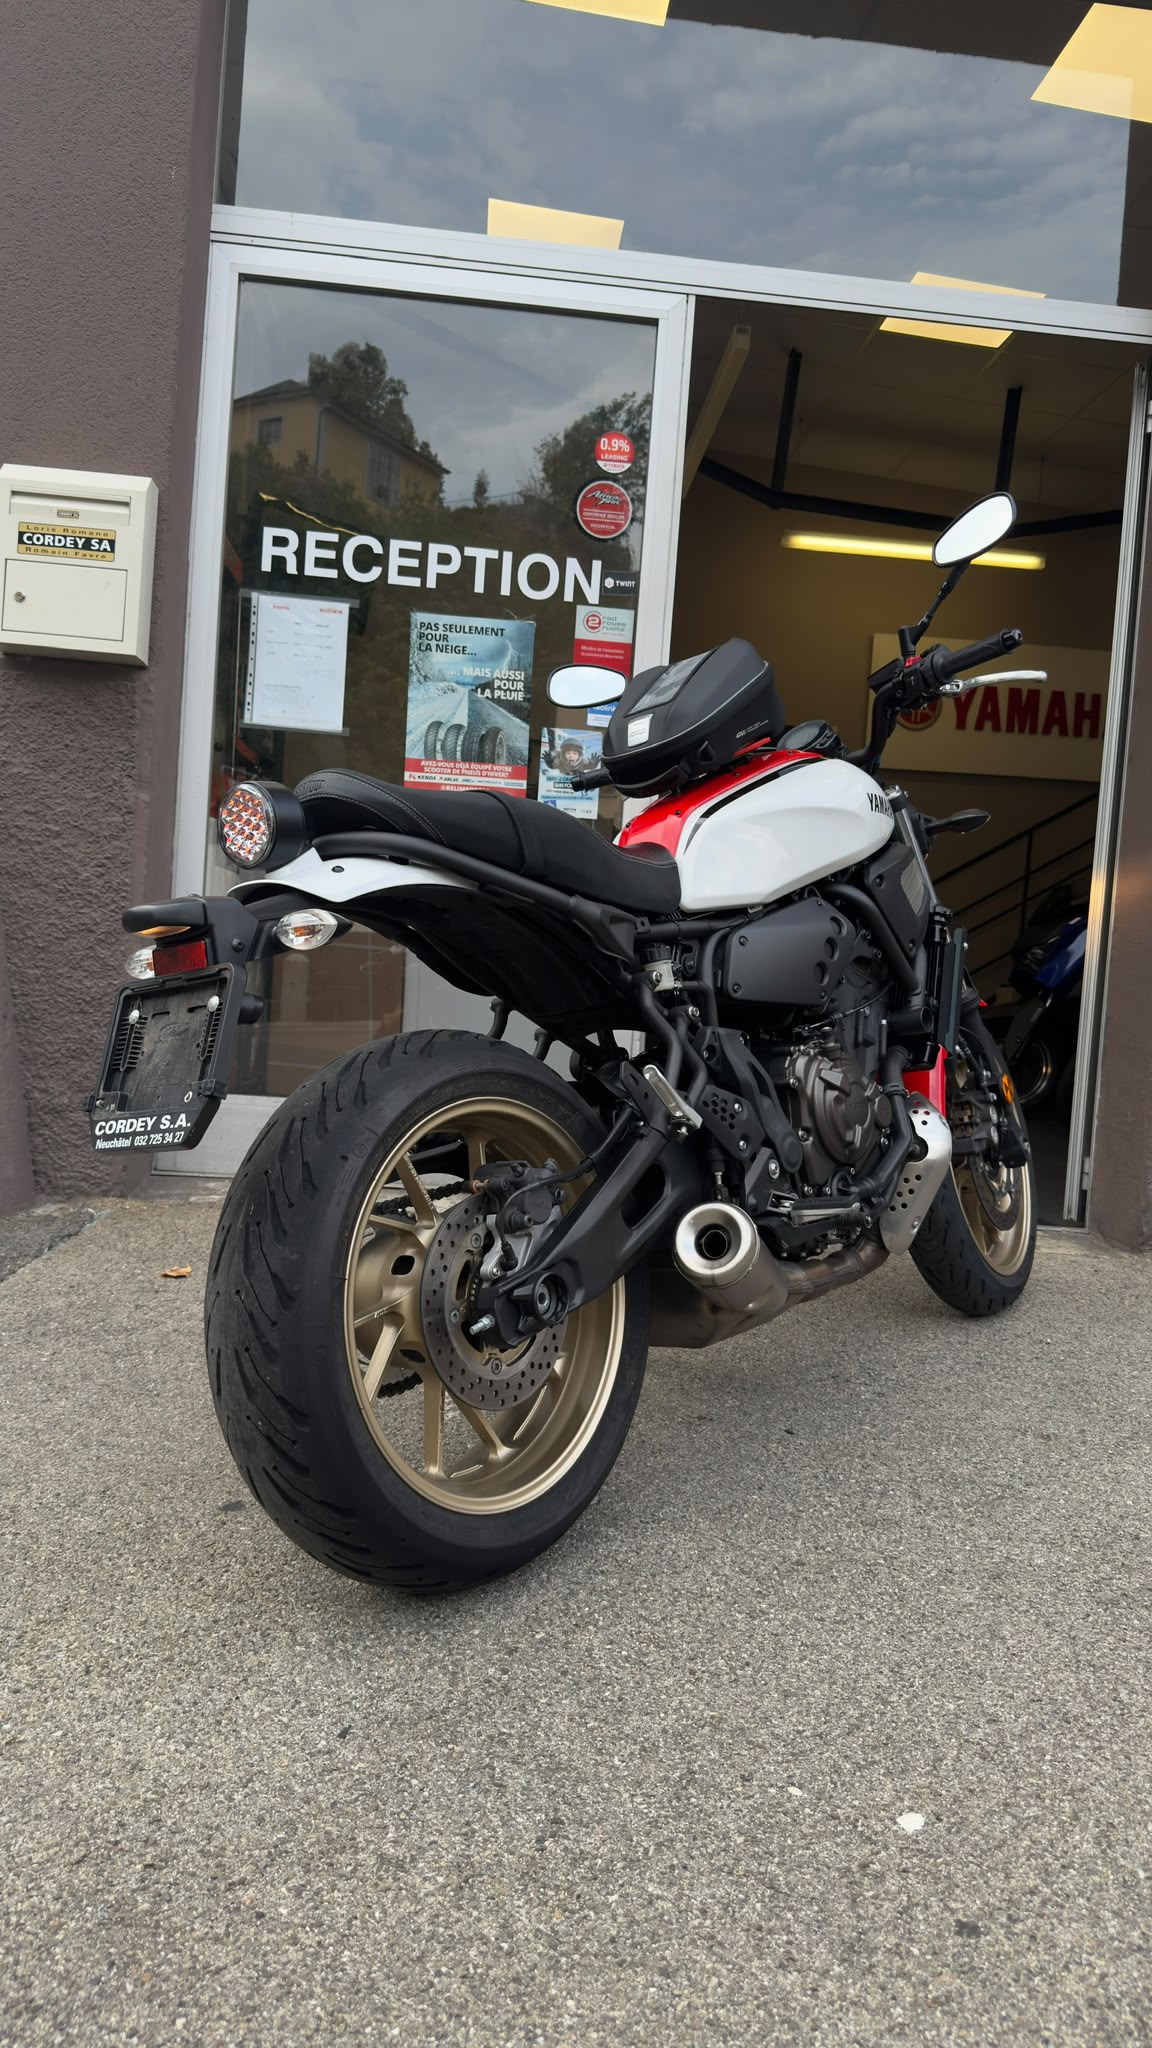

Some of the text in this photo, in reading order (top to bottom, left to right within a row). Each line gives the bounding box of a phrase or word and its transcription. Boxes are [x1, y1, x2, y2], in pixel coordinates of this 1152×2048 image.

[600, 438, 630, 452] 0.9%
[26, 524, 109, 537] Loris Romano
[23, 532, 111, 552] CORDEY SA
[25, 546, 68, 556] Romain
[261, 526, 602, 605] RECEPTION
[419, 621, 506, 638] PAS SEULEMENT
[419, 632, 449, 643] POUR
[418, 642, 477, 656] LA NEIGE...
[463, 666, 492, 678] MAIS
[493, 668, 525, 680] AUSSI
[494, 680, 525, 691] POUR
[477, 688, 524, 701] LA PLUIE
[952, 686, 1104, 739] YAMAH
[421, 760, 455, 769] AVEZ-VOUS
[455, 761, 470, 769] DÉJÀ
[471, 762, 492, 771] ÉQUIPÉ
[461, 768, 481, 776] PNEUS
[481, 770, 509, 778] D'HIVER?
[866, 792, 893, 817] YAM
[95, 1113, 191, 1136] CORDEY S.A.
[95, 1131, 185, 1150] Neuchâtel 032 725 34 27
